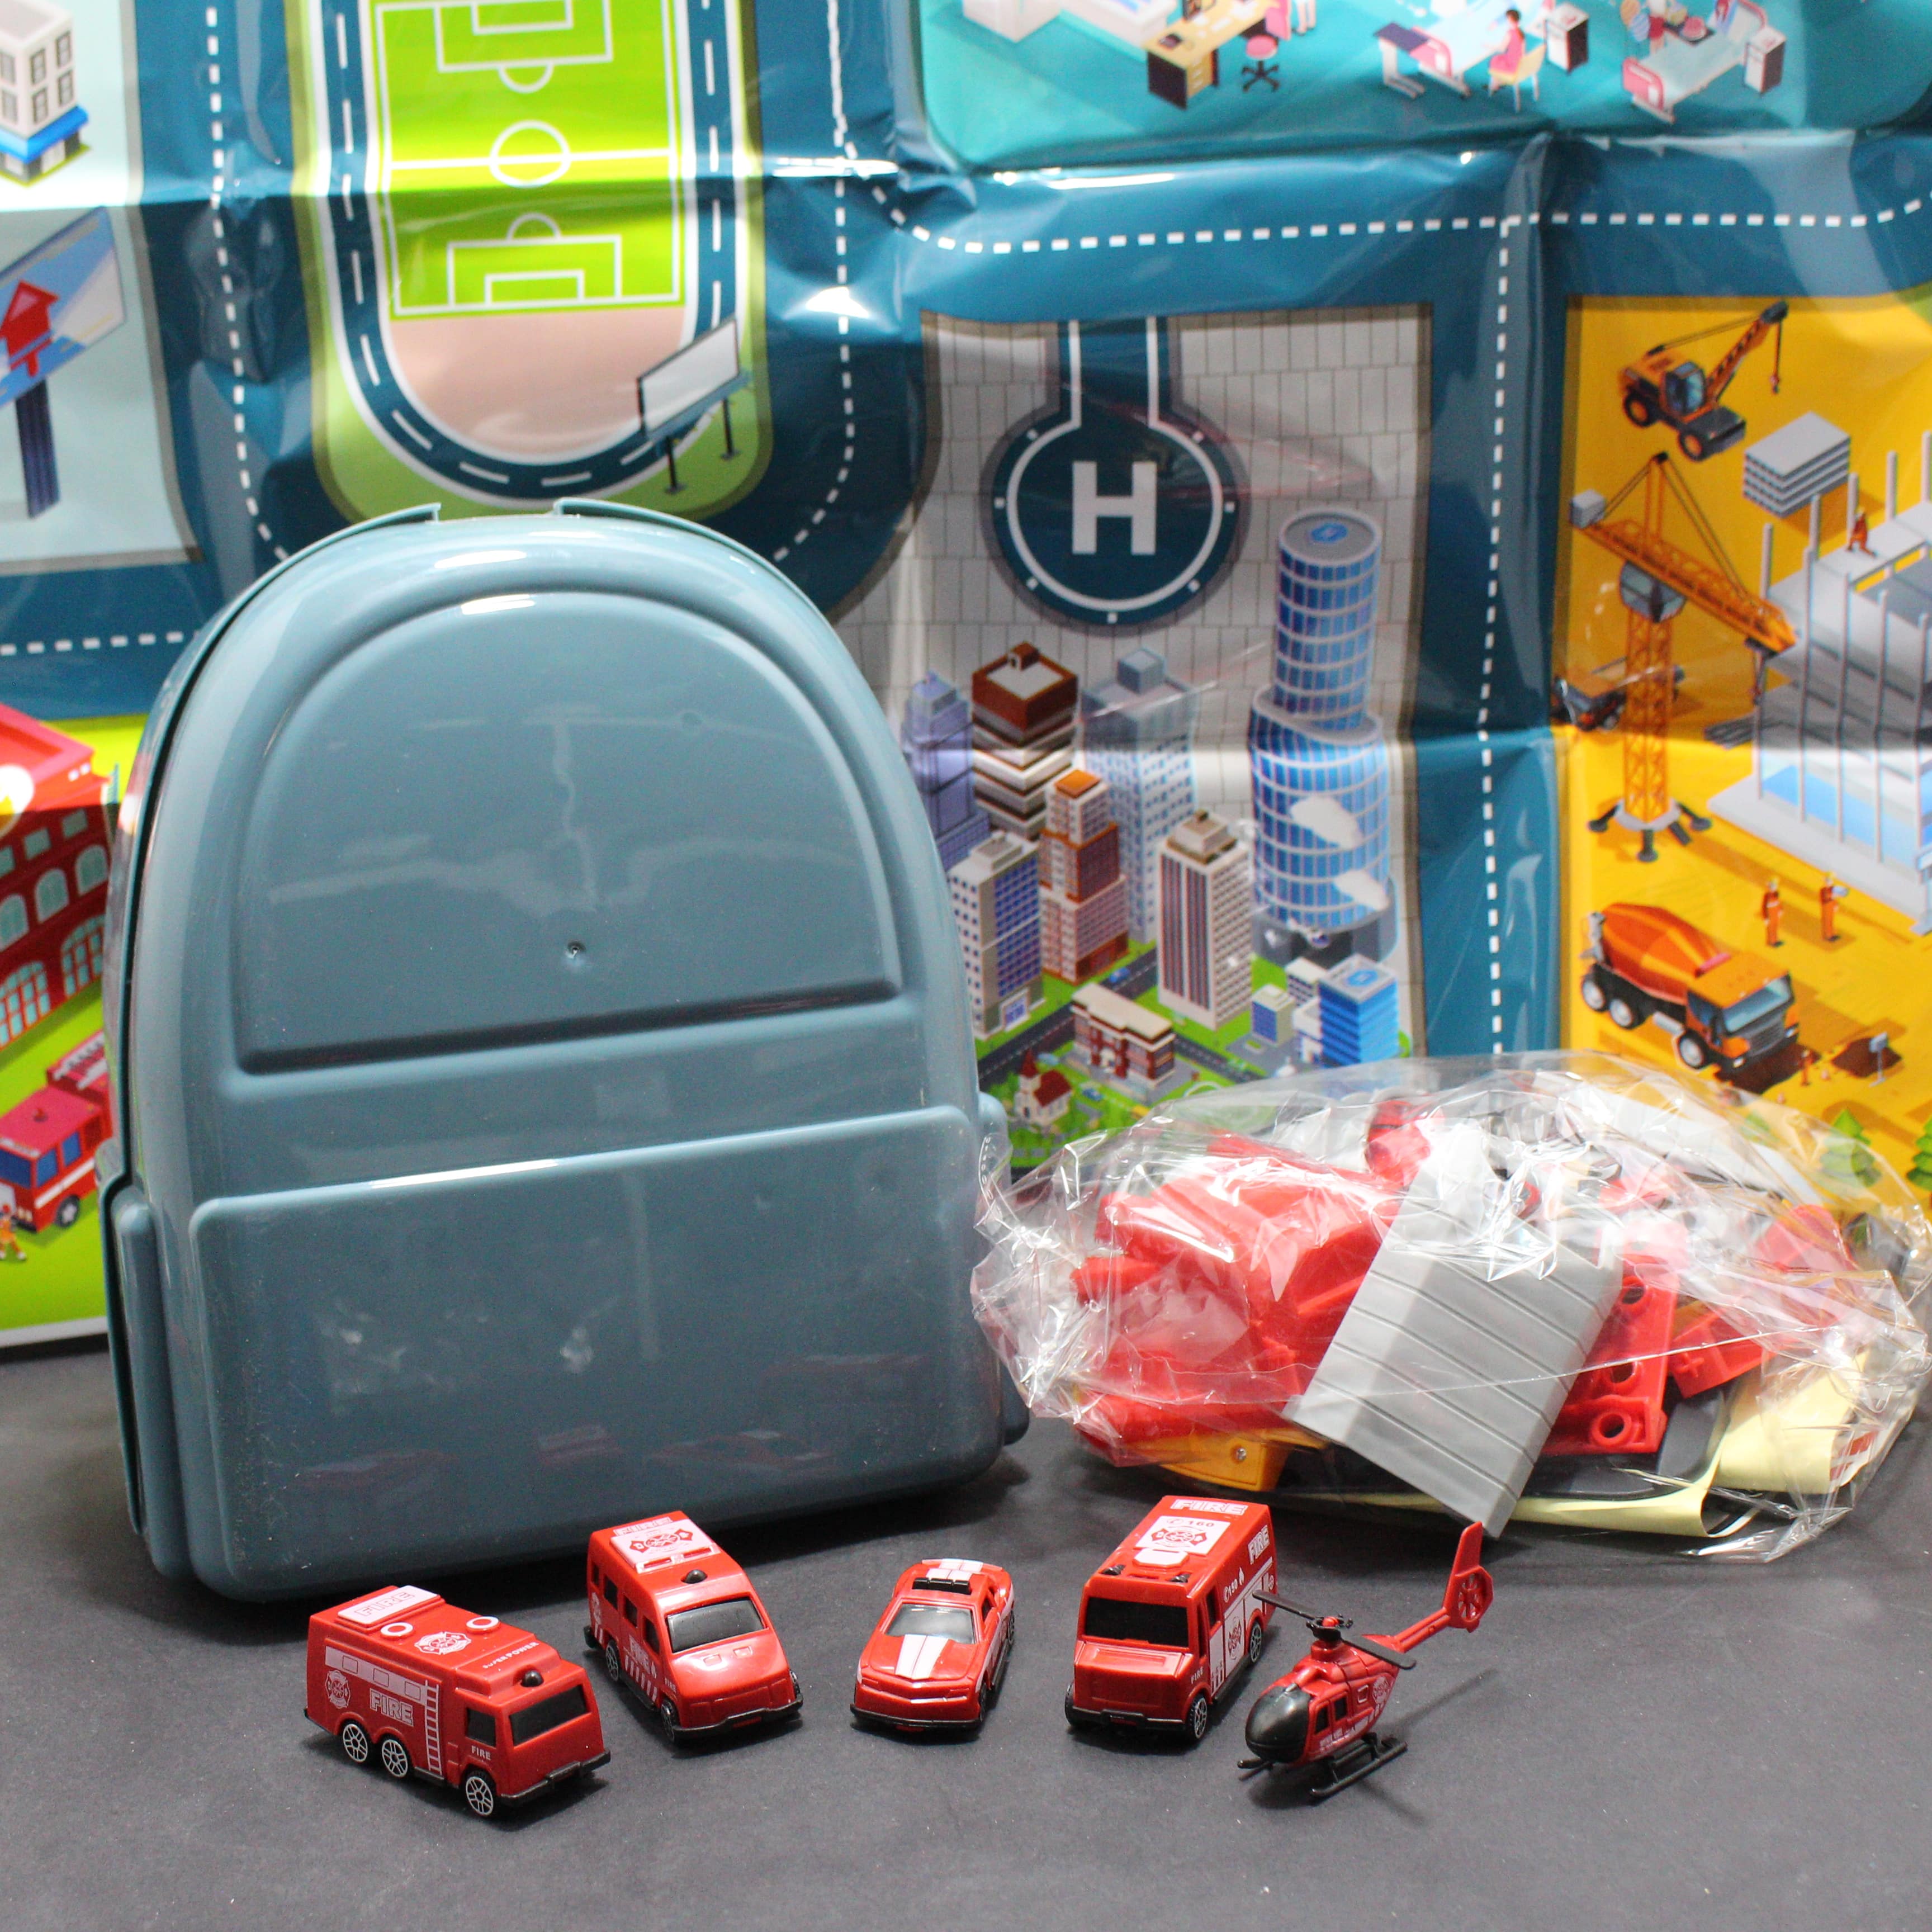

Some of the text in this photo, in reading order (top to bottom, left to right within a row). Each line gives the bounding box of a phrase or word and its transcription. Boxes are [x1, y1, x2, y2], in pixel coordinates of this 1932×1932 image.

[1073, 461, 1157, 554] H
[1170, 1499, 1248, 1516] FIRE
[1248, 1524, 1270, 1565] FIRE
[354, 1592, 415, 1616] FIRE
[505, 1642, 539, 1658] POWER
[1191, 1666, 1204, 1684] FIRE
[370, 1688, 414, 1727] FIRE
[471, 1745, 491, 1761] FIRE
